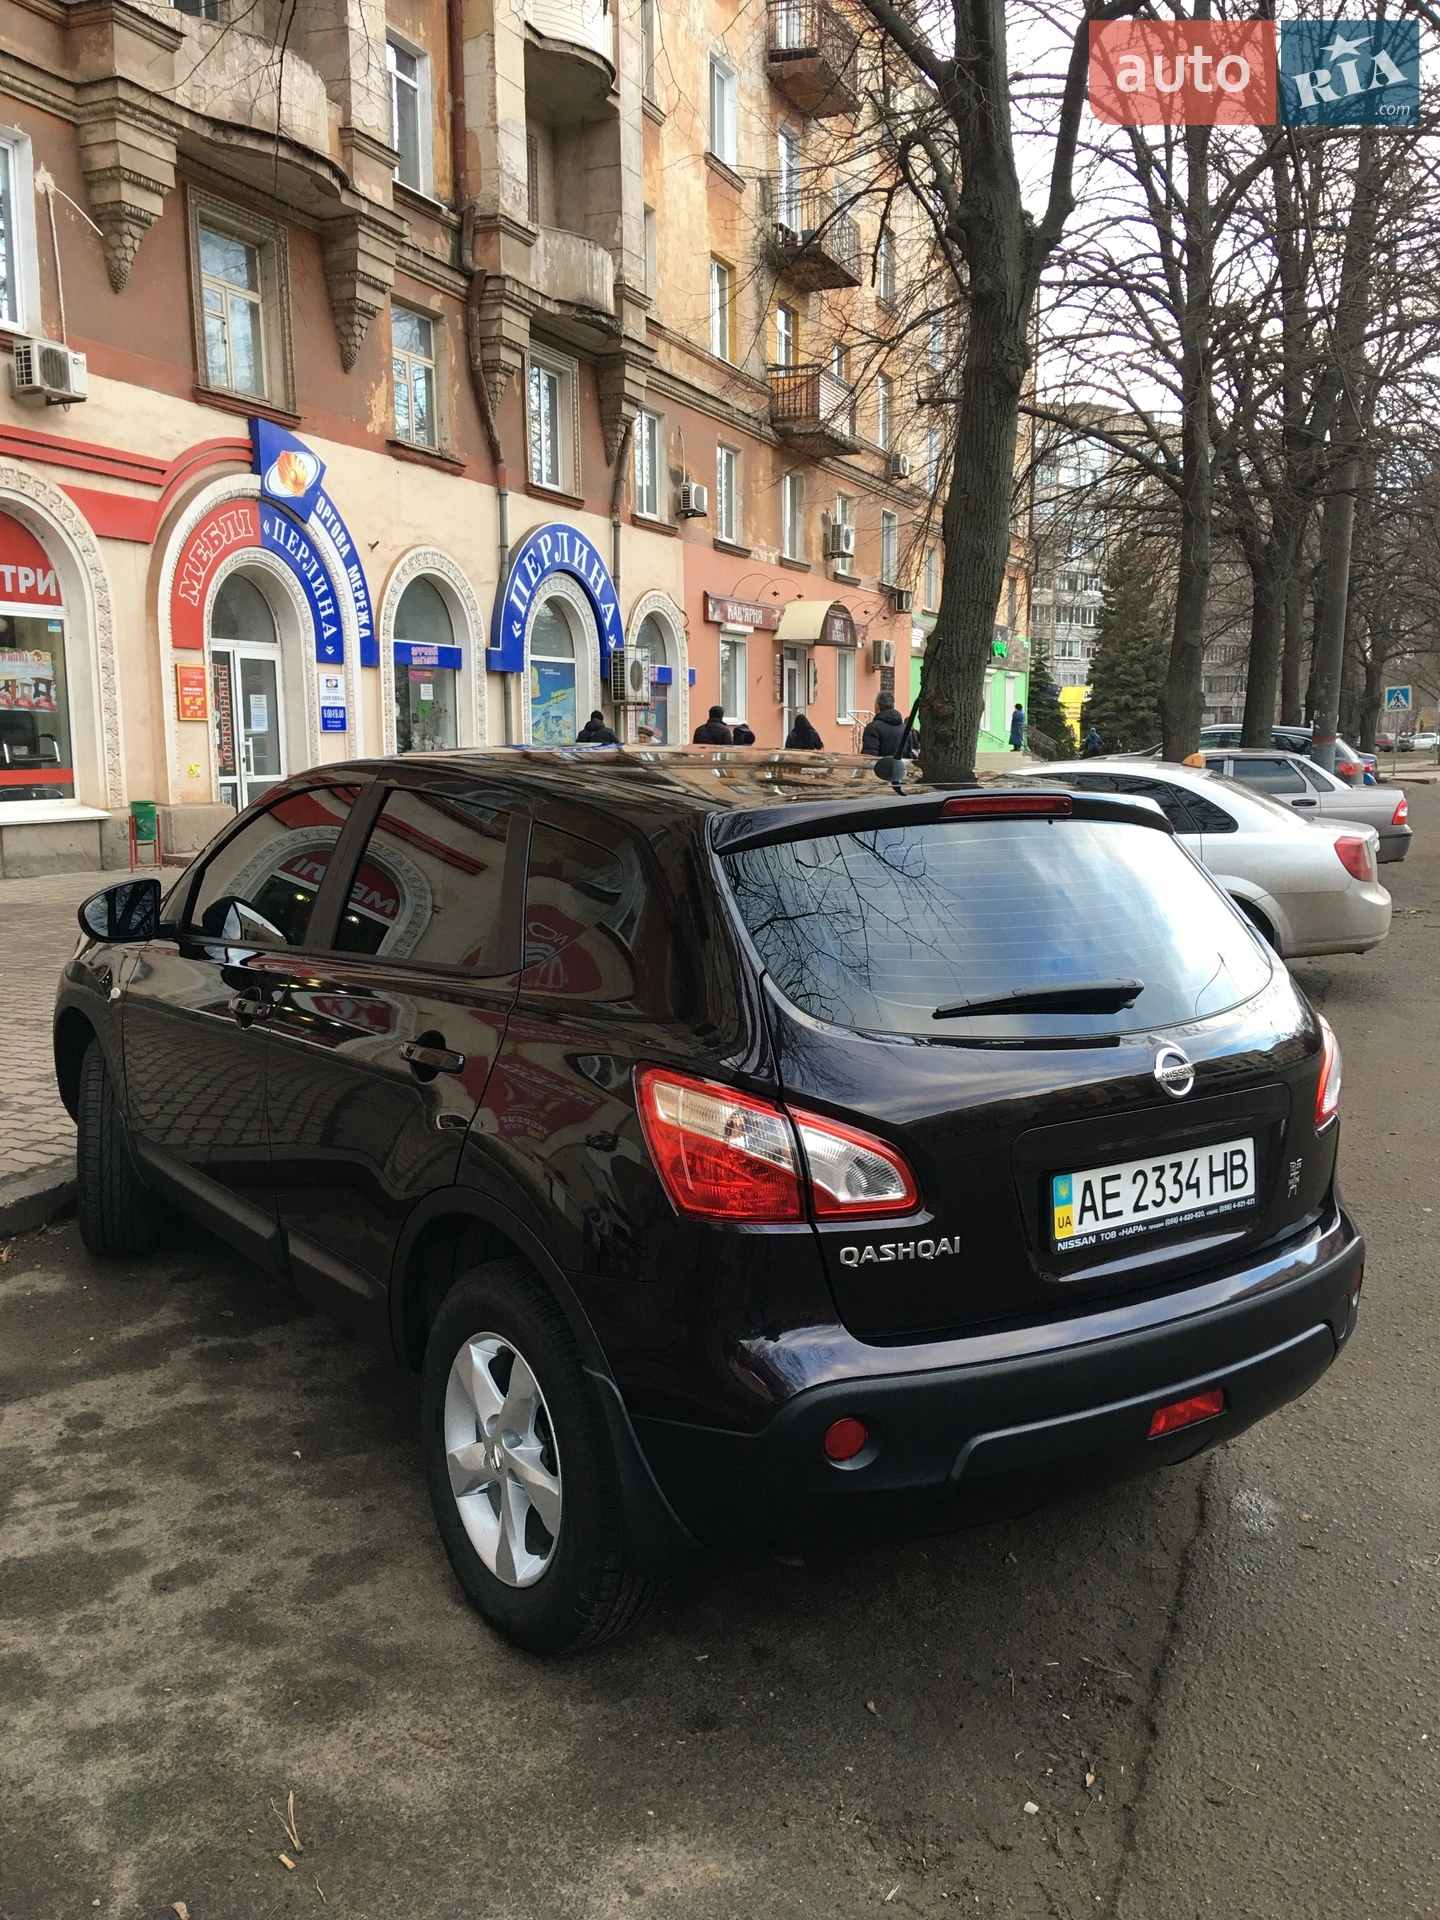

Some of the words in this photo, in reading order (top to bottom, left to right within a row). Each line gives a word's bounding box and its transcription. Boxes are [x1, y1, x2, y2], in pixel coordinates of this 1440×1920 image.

[179, 509, 254, 607] МЕБЛІ
[347, 563, 372, 638] МЕРЕЖА
[1161, 1065, 1194, 1079] NISSAN
[1078, 1173, 1124, 1226] AE
[1131, 1157, 1201, 1214] 2334
[1208, 1148, 1249, 1196] HB
[1058, 1215, 1073, 1229] UA
[839, 1236, 960, 1267] QASHQAI
[1057, 1234, 1097, 1252] NISSAN
